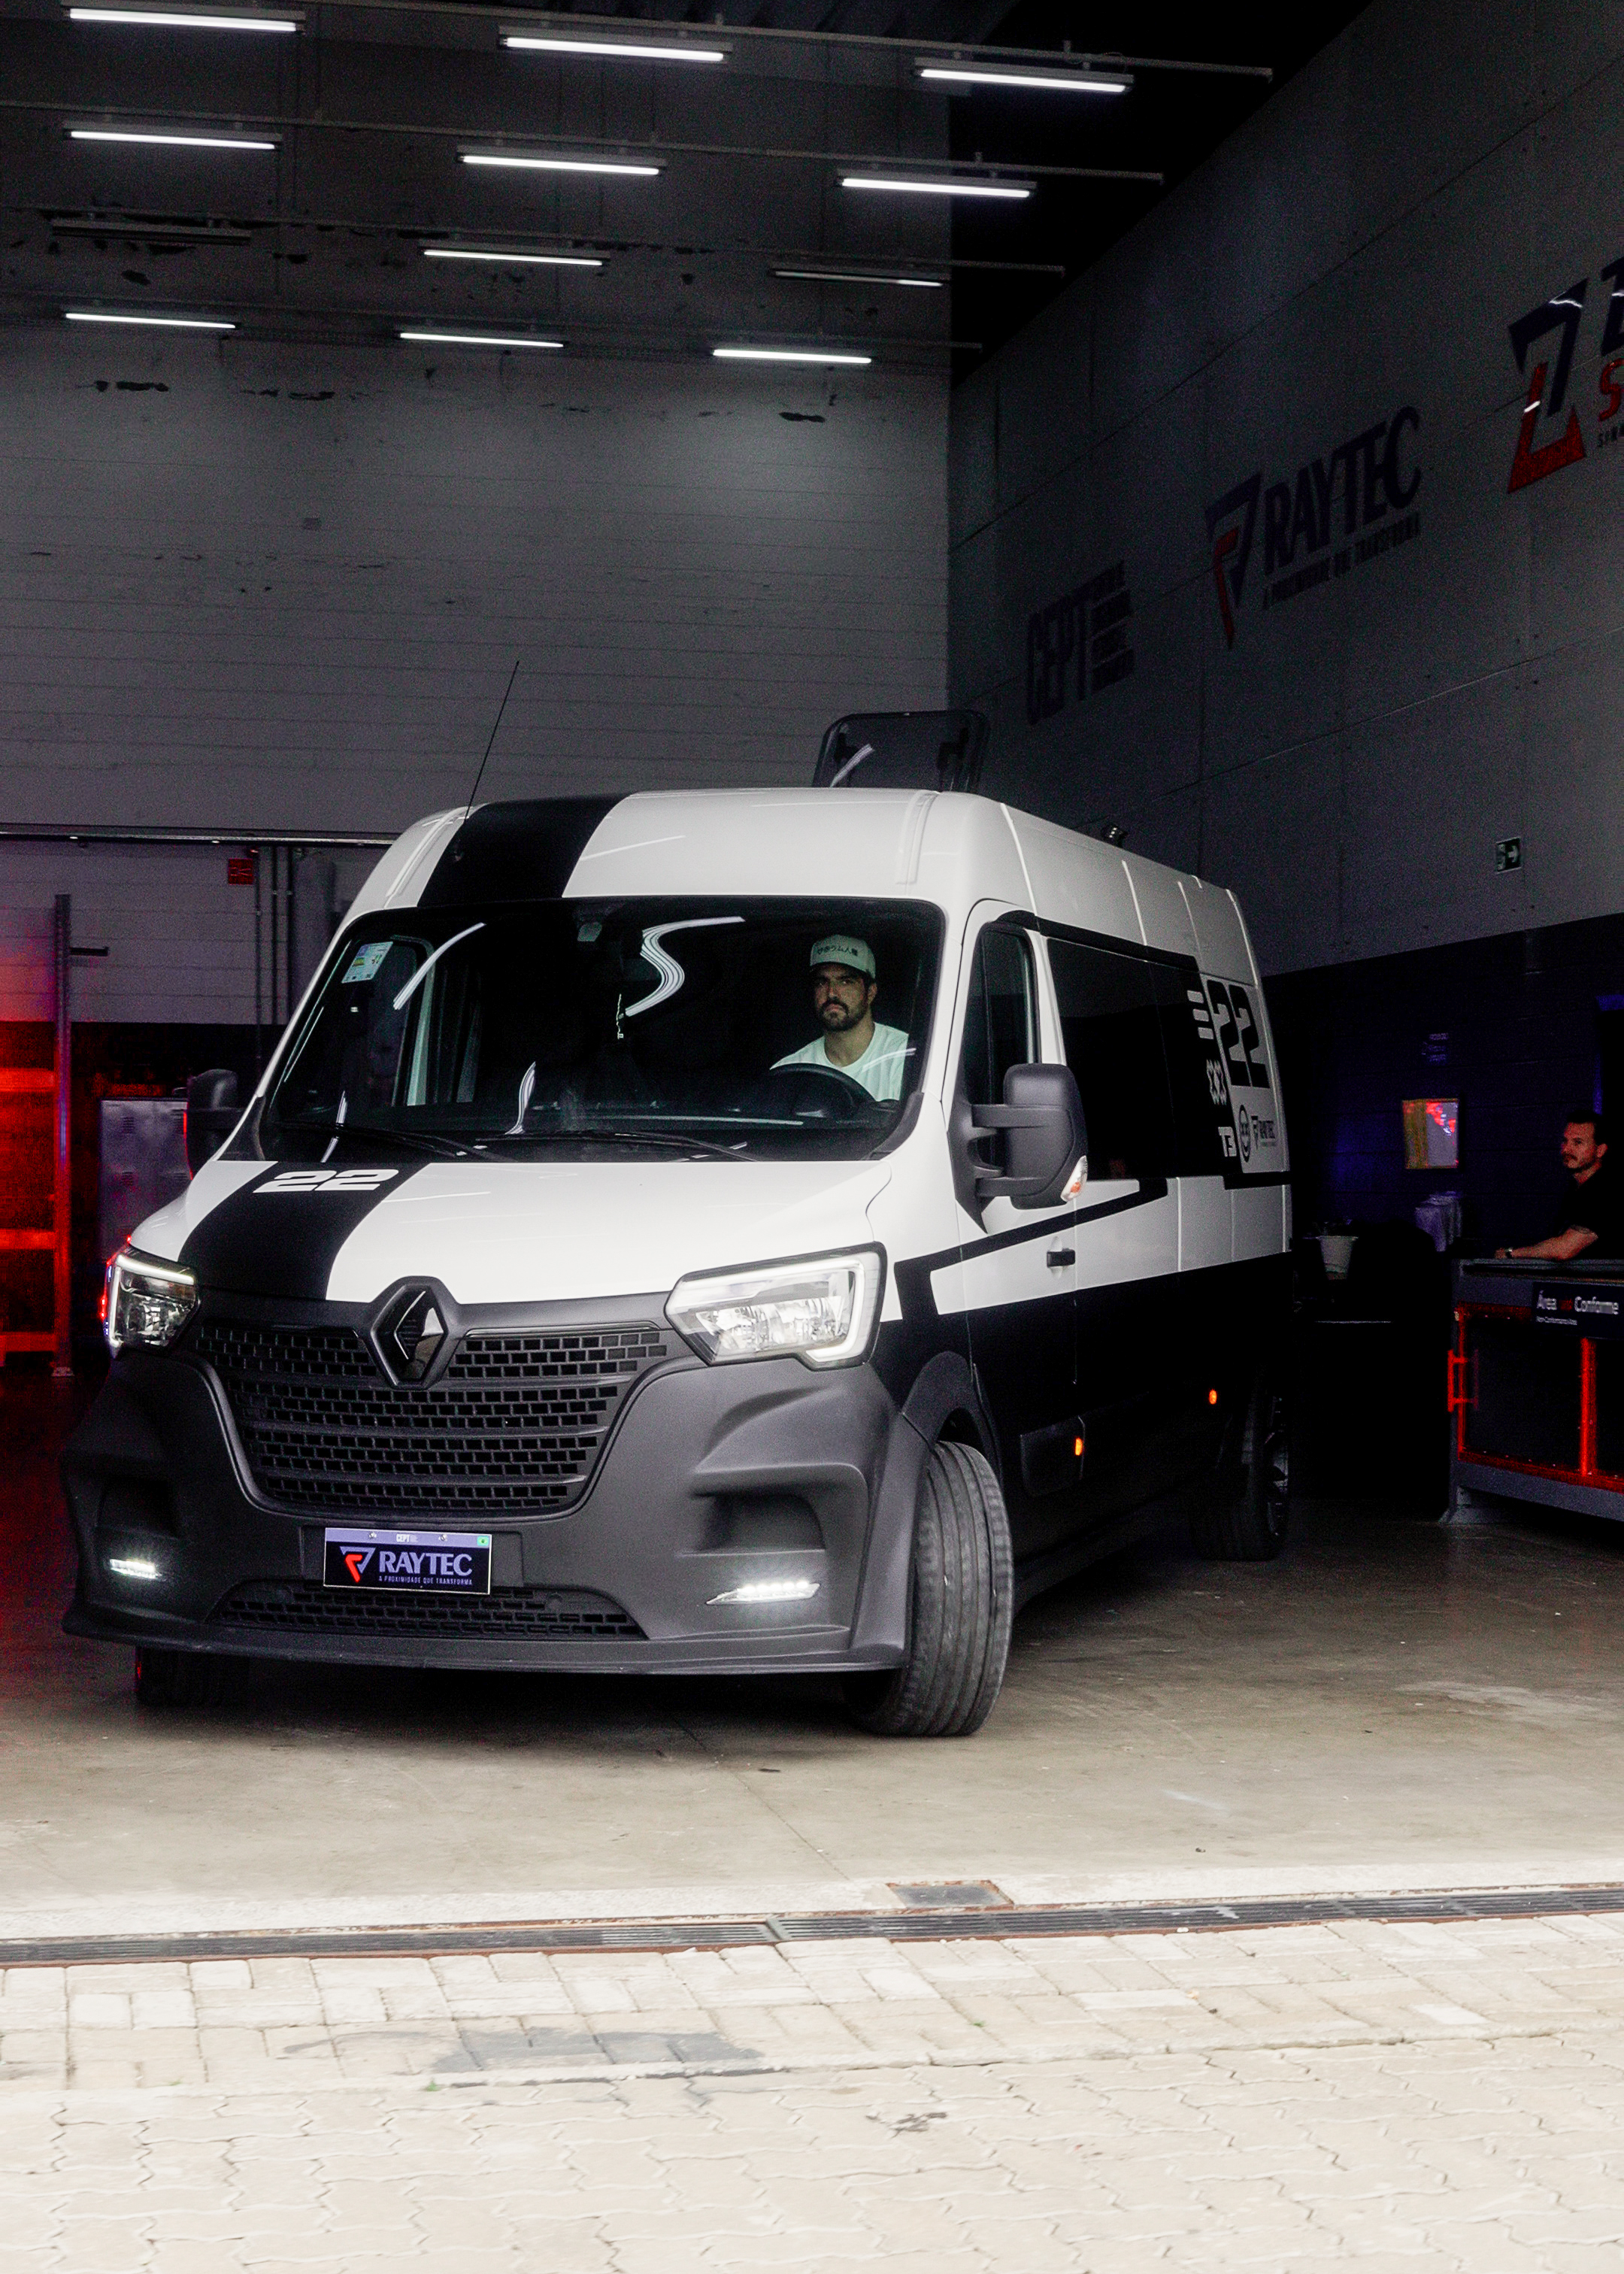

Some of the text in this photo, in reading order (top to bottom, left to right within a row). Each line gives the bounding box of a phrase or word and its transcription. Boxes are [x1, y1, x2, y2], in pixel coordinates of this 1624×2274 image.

[1265, 406, 1421, 576] RAYTEC
[1207, 980, 1271, 1089] 22
[253, 1169, 399, 1193] 22
[379, 1550, 473, 1576] RAYTEC
[423, 1576, 434, 1584] QUE
[436, 1577, 473, 1586] TRANSFORMA
